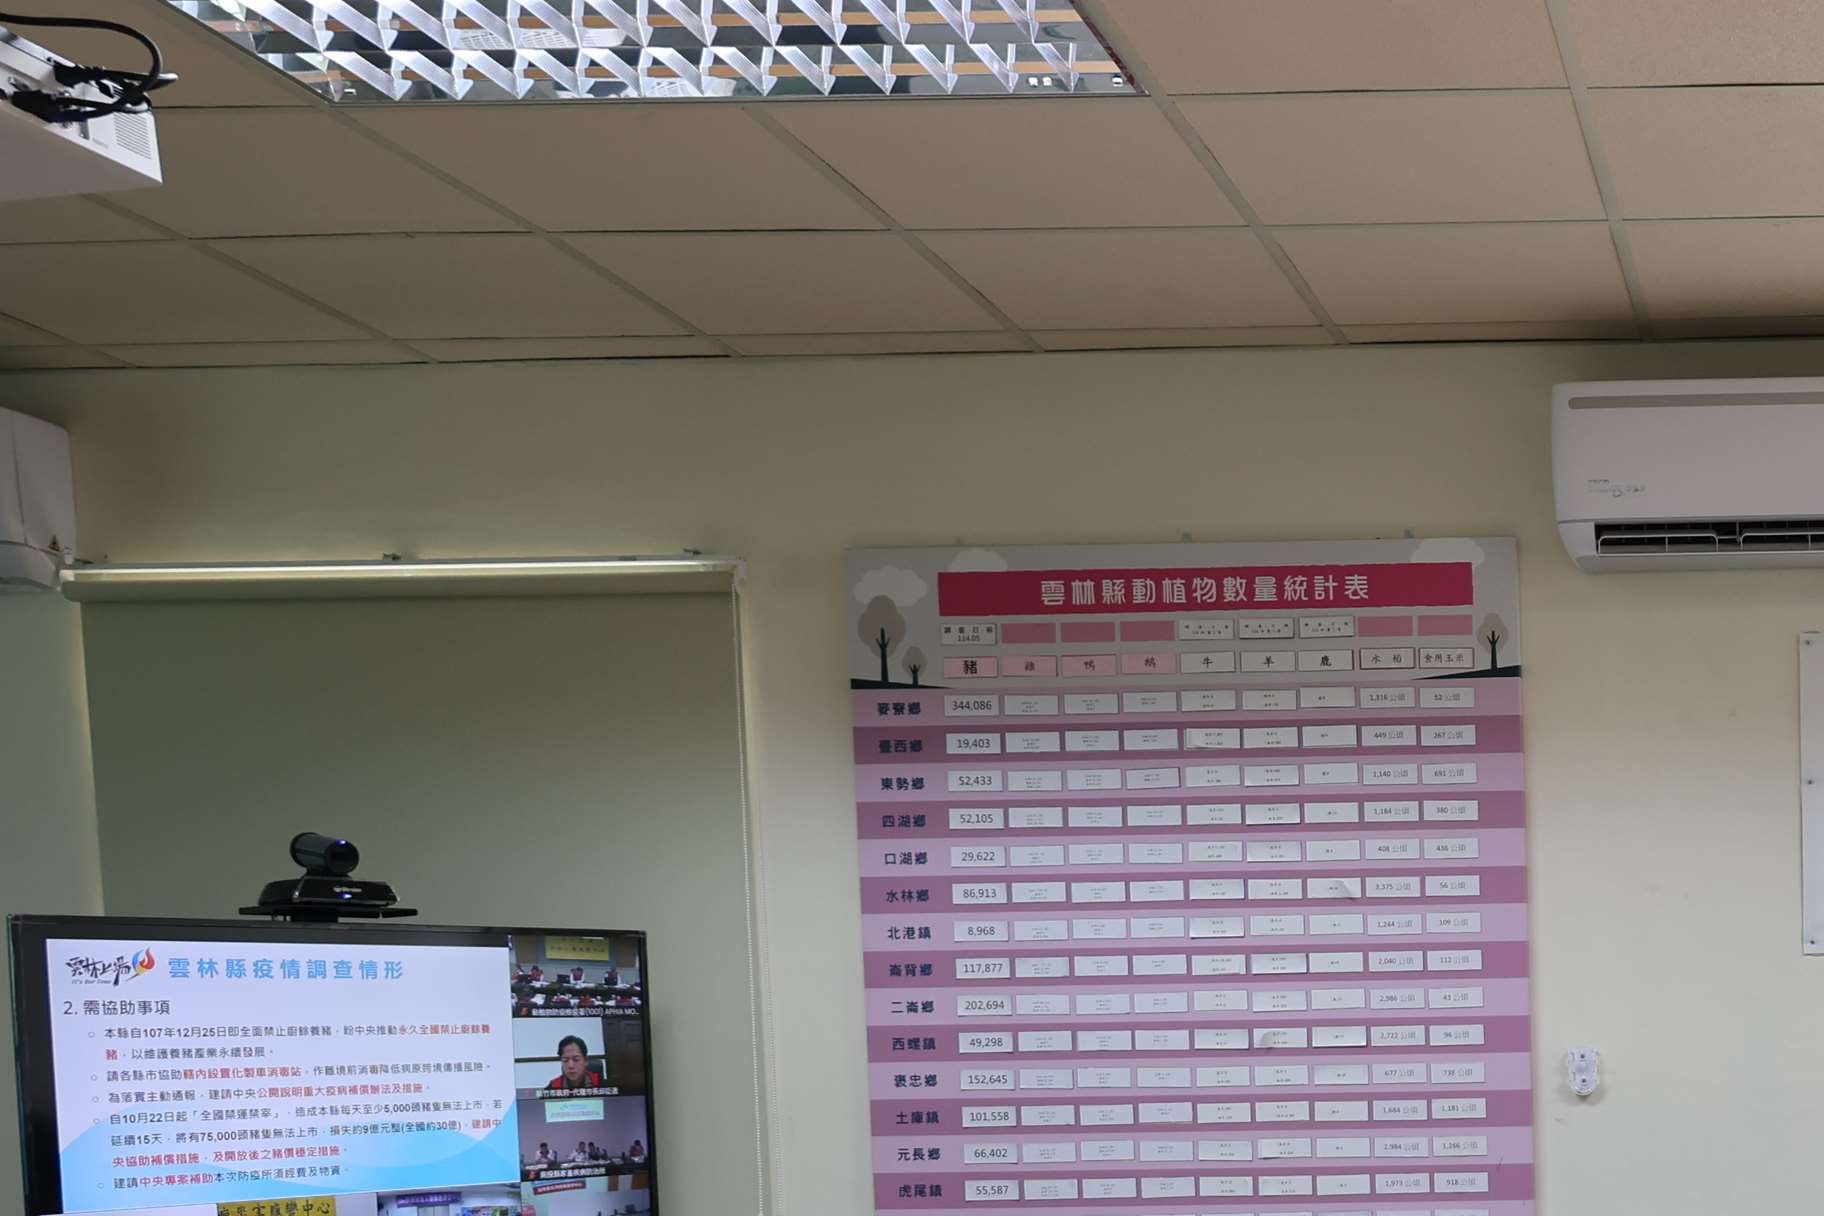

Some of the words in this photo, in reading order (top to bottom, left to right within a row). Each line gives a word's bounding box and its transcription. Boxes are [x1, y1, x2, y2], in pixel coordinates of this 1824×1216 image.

[1040, 574, 1369, 606] 雲林縣動植物數量統計表
[962, 659, 978, 675] 豬
[877, 702, 921, 715] 麥寮鄉
[952, 700, 992, 711] 344,086
[879, 740, 923, 752] 臺西鄉
[956, 739, 991, 749] 19,403
[881, 777, 925, 790] 東勢鄉
[959, 776, 992, 787] 52,433
[882, 815, 926, 827] 四湖鄉
[960, 814, 993, 824] 52,105
[884, 852, 928, 865] 口湖鄉
[961, 852, 995, 862] 29,622
[886, 890, 930, 902] 水林鄉
[963, 889, 997, 899] 86,913
[888, 927, 931, 939] 北港鎮
[968, 927, 995, 936] 8,968
[168, 958, 403, 979] 雲林縣疫情調查情形
[889, 964, 933, 976] 崙背鄉
[963, 964, 1003, 974] 117,877
[63, 1001, 78, 1015] 2.
[84, 1000, 171, 1016] 需協助事項
[891, 1001, 934, 1013] 二崙鄉
[965, 1001, 1004, 1011] 202,694
[892, 1038, 936, 1050] 西螺鎮
[969, 1038, 1003, 1048] 49,298
[894, 1074, 938, 1087] 褒忠鄉
[968, 1075, 1008, 1085] 152,645
[896, 1111, 939, 1124] 土庫鎮
[969, 1112, 1009, 1121] 101,558
[898, 1148, 941, 1161] 元長鄉
[974, 1149, 1008, 1158] 66,402
[899, 1184, 942, 1197] 虎尾鎮
[976, 1186, 1009, 1196] 55,587
